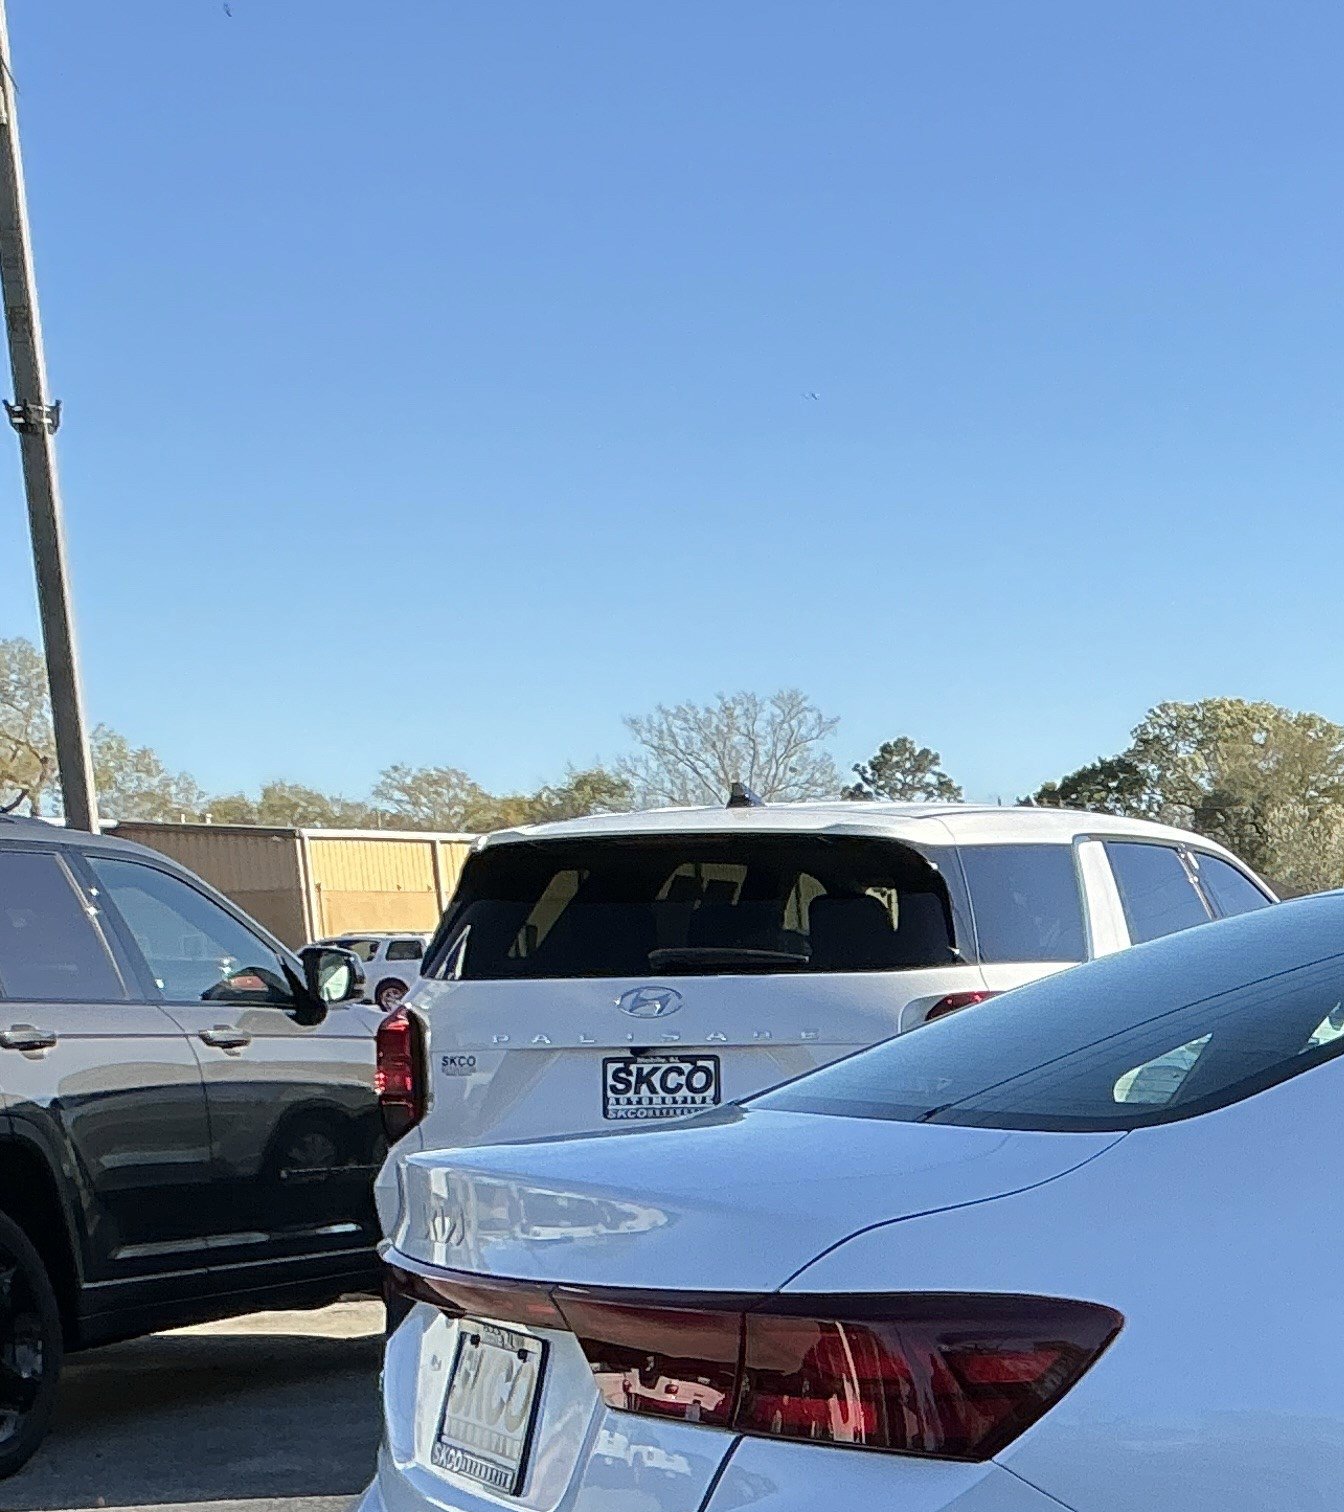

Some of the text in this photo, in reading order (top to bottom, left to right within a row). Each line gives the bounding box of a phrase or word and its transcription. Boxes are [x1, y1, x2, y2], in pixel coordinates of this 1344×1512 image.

[492, 1033, 818, 1045] PALISADE
[442, 1055, 476, 1067] SKCO
[609, 1065, 714, 1095] SKCO
